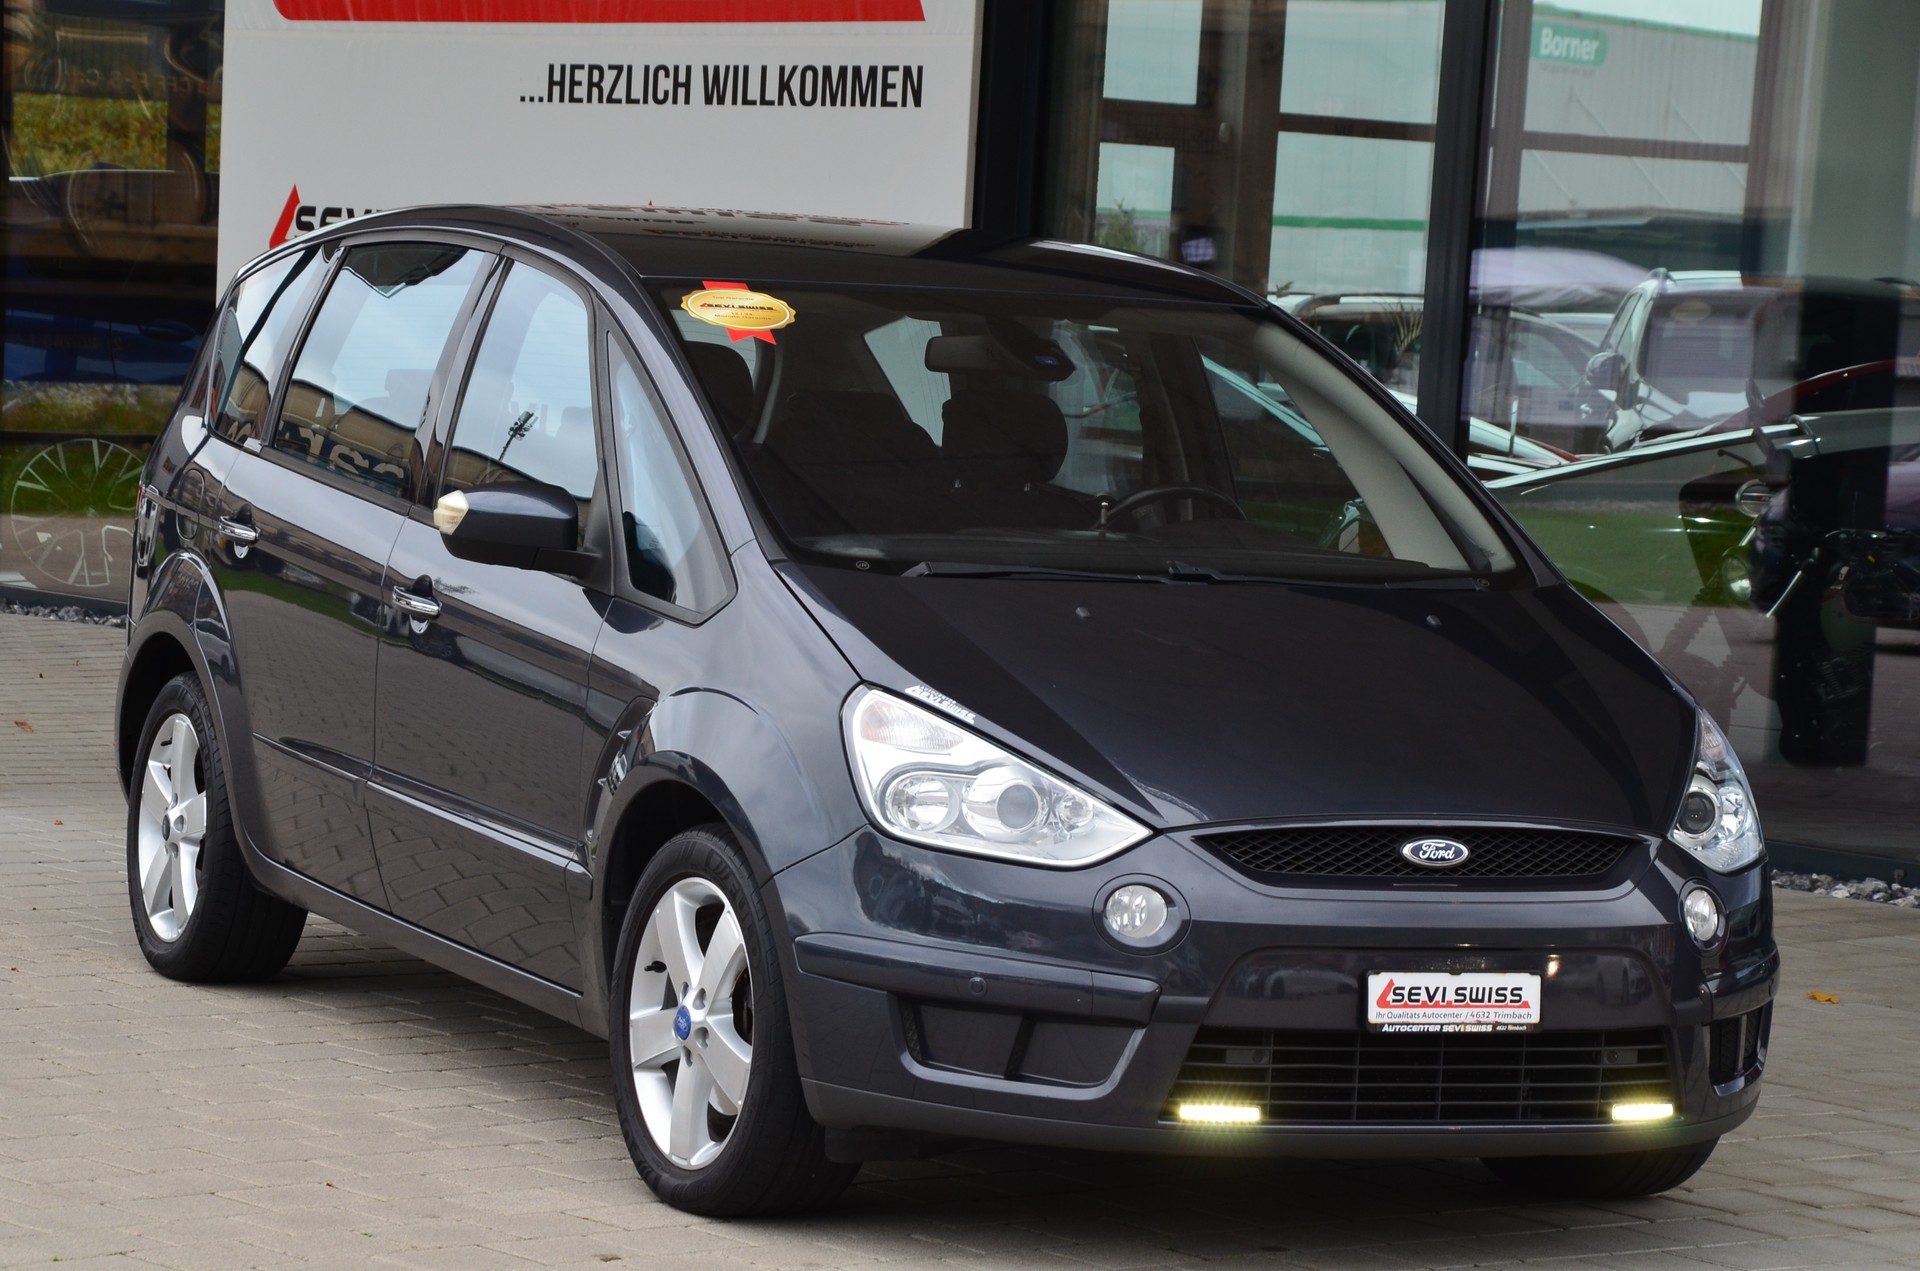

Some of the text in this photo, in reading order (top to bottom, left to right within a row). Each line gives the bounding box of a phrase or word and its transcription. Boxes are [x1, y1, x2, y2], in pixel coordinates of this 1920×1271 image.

[702, 64, 924, 108] WILLKOMMEN
[1419, 842, 1456, 860] Ford
[1392, 986, 1523, 1003] SEVI SWISS
[1421, 1011, 1463, 1020] Autocenter
[1493, 1012, 1532, 1020] Trimbach
